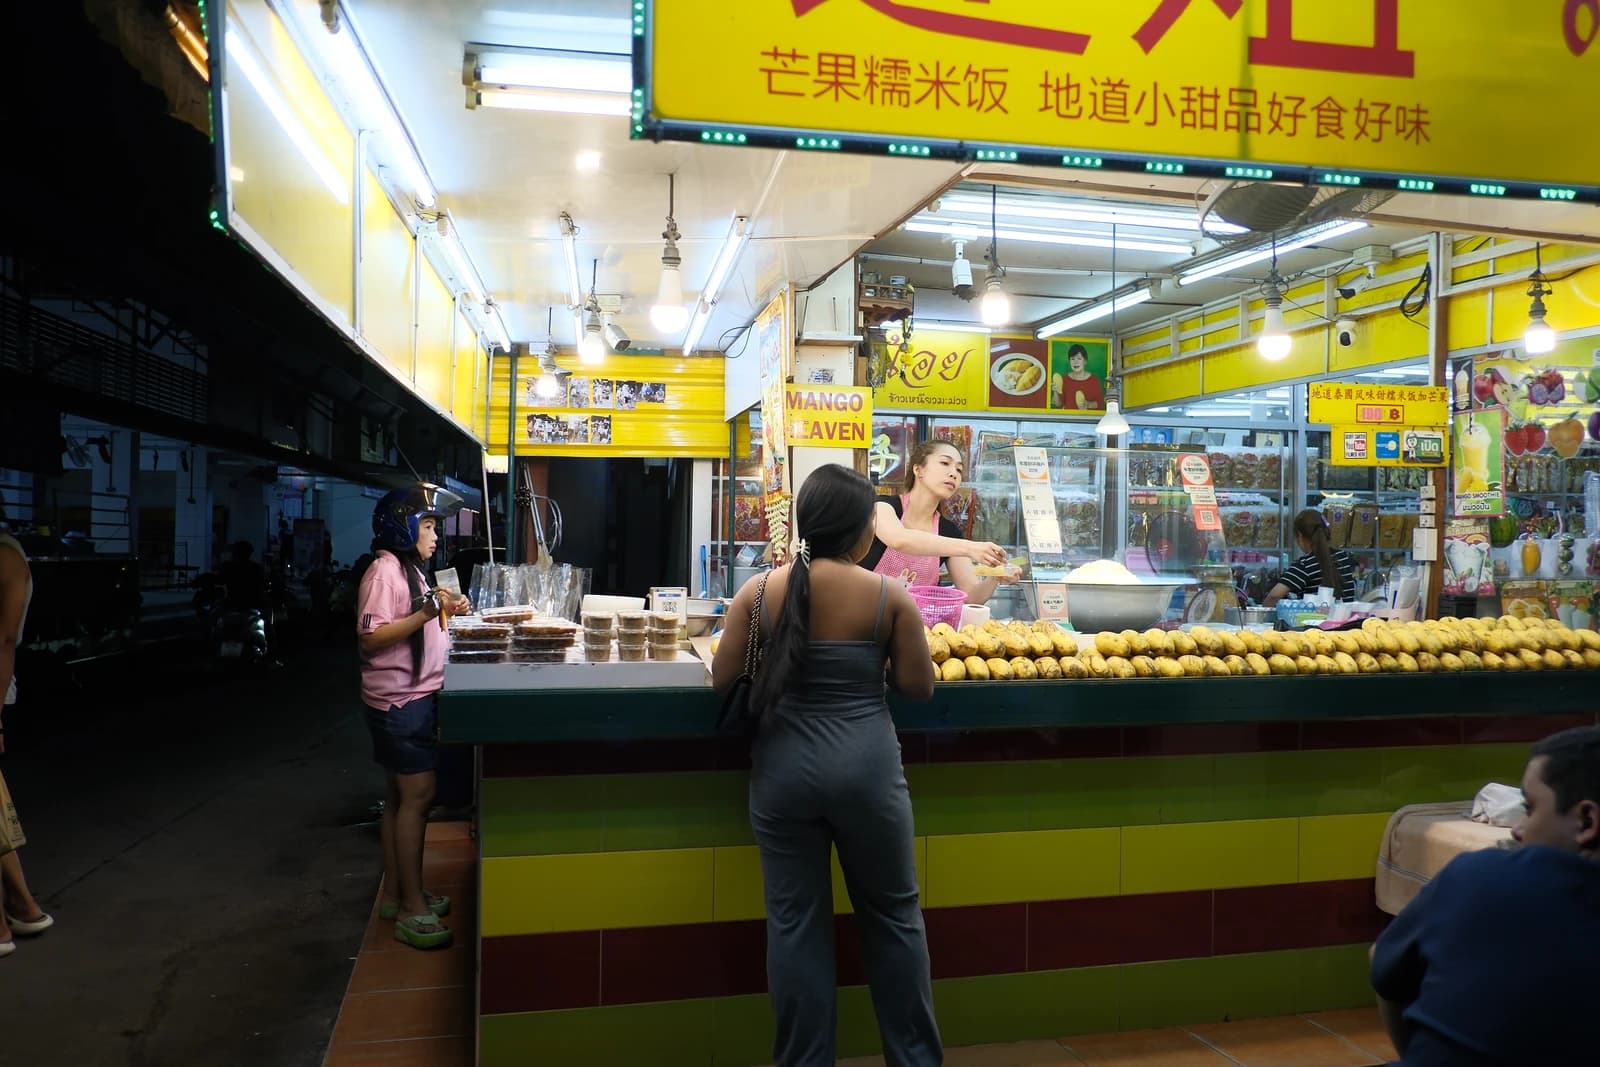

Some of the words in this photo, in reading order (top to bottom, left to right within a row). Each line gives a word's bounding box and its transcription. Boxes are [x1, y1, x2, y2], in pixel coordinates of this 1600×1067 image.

[759, 46, 1009, 114] 芒果糯米饭
[1039, 71, 1432, 145] 地道小甜品好食好味
[785, 390, 864, 412] MANGO
